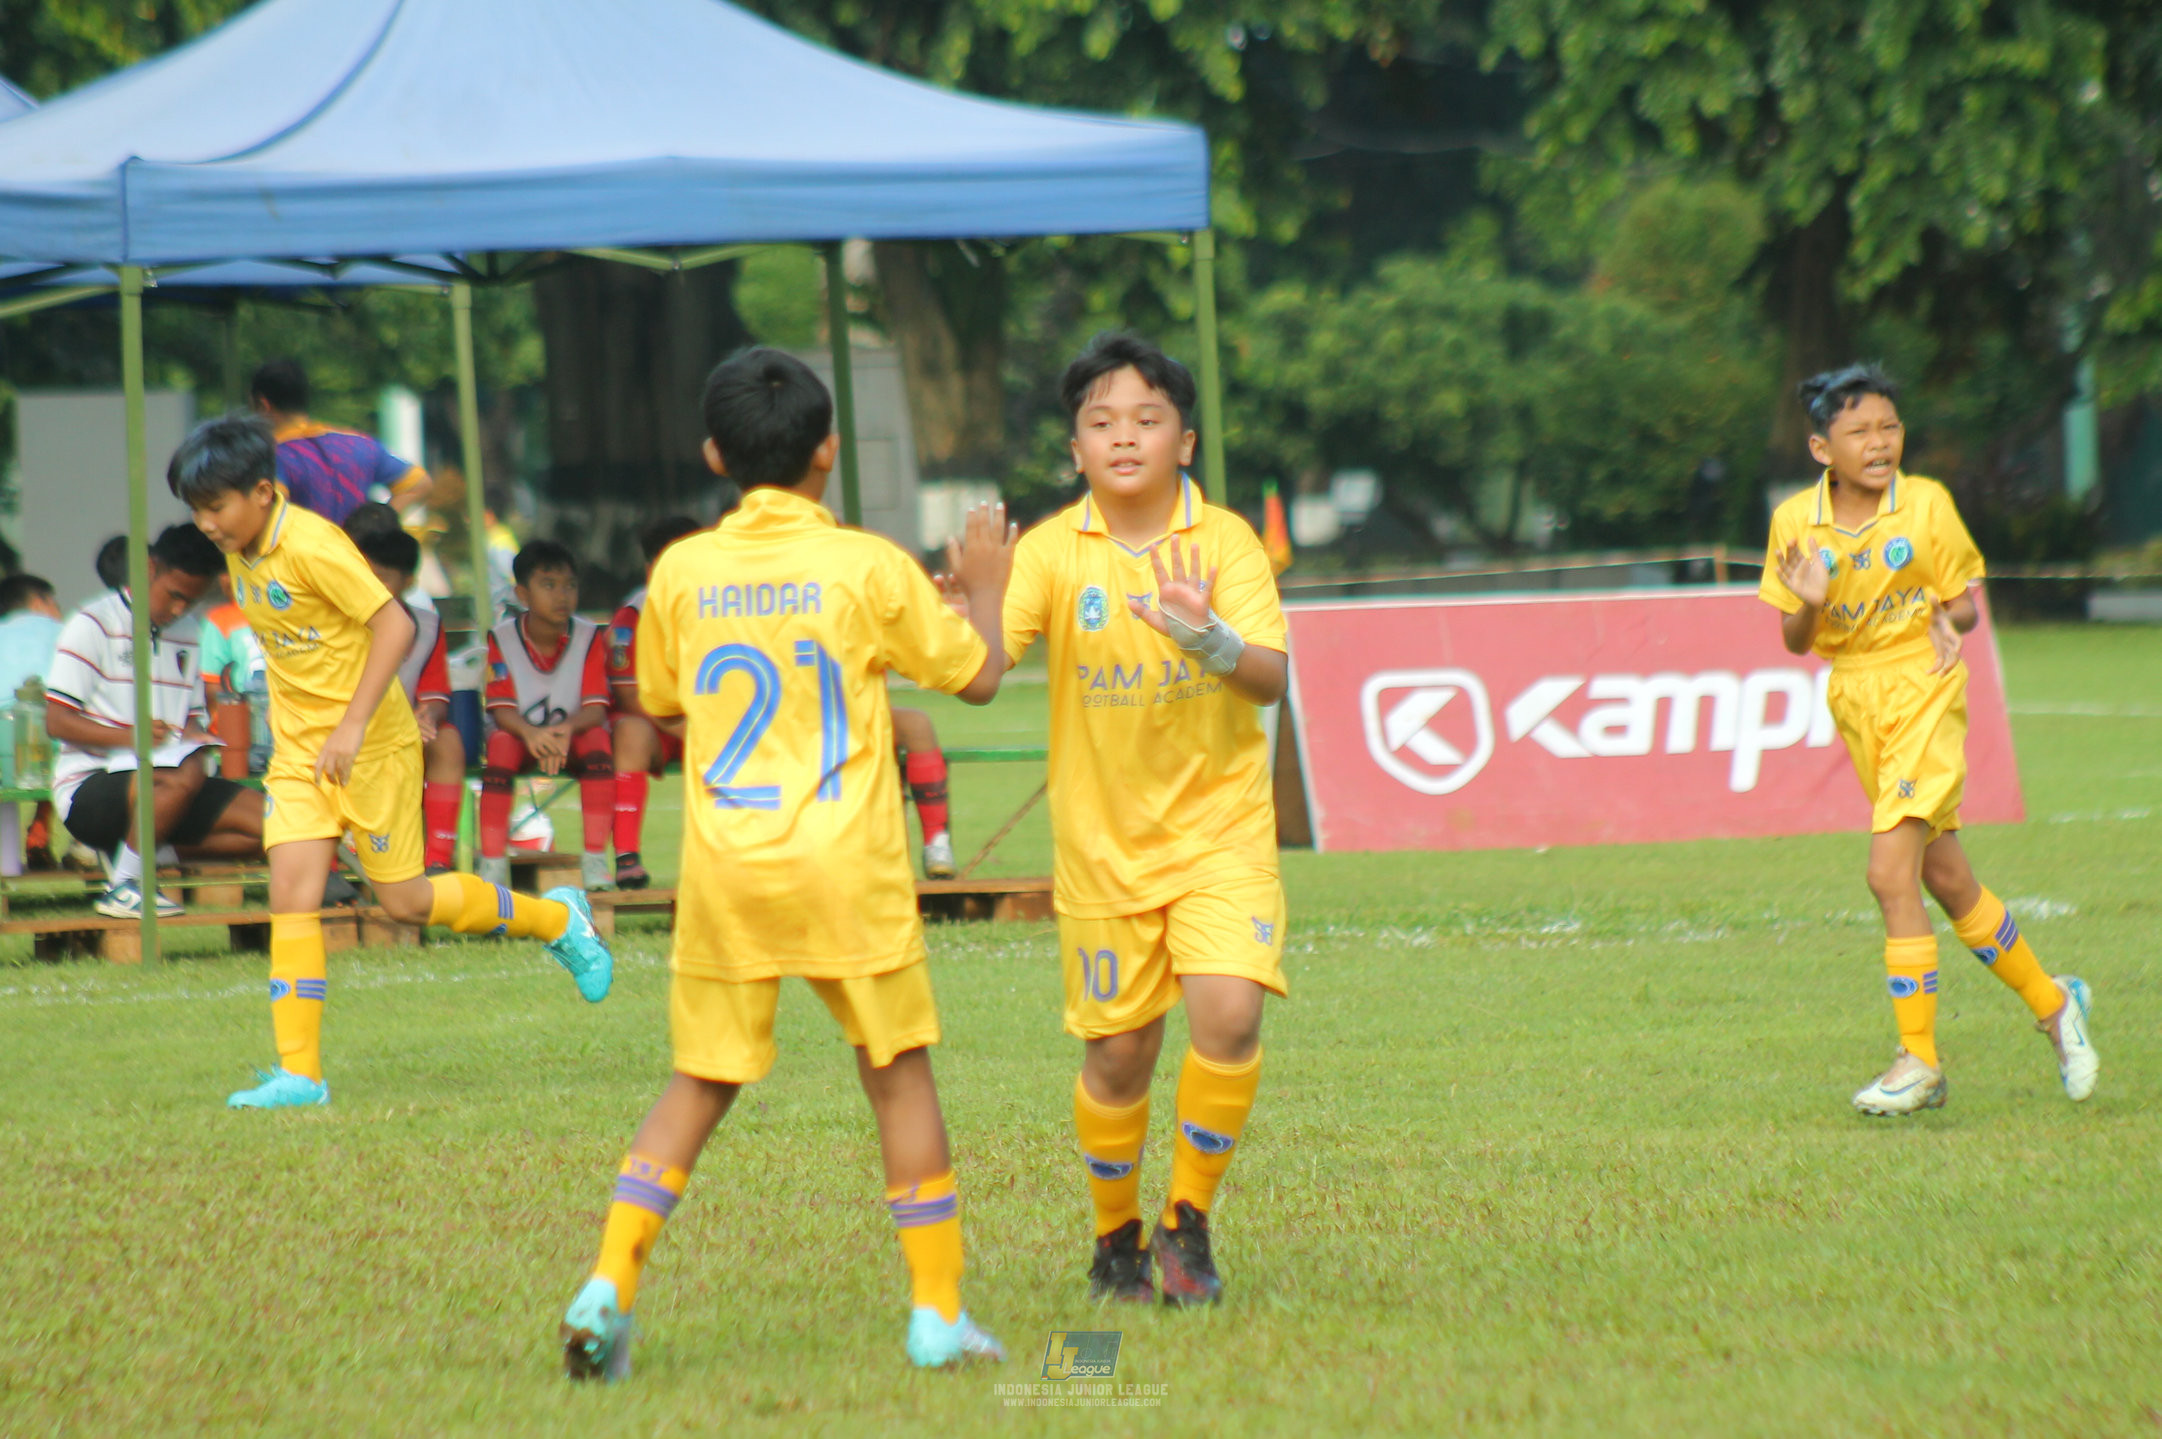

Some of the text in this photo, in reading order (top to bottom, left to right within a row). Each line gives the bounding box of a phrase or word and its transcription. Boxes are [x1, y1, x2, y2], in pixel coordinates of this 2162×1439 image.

[698, 581, 822, 619] HAIDAR
[1157, 659, 1209, 687] JA
[1083, 680, 1223, 708] OOTBALL ACADEM
[694, 637, 848, 811] 21
[1077, 947, 1118, 1002] 10
